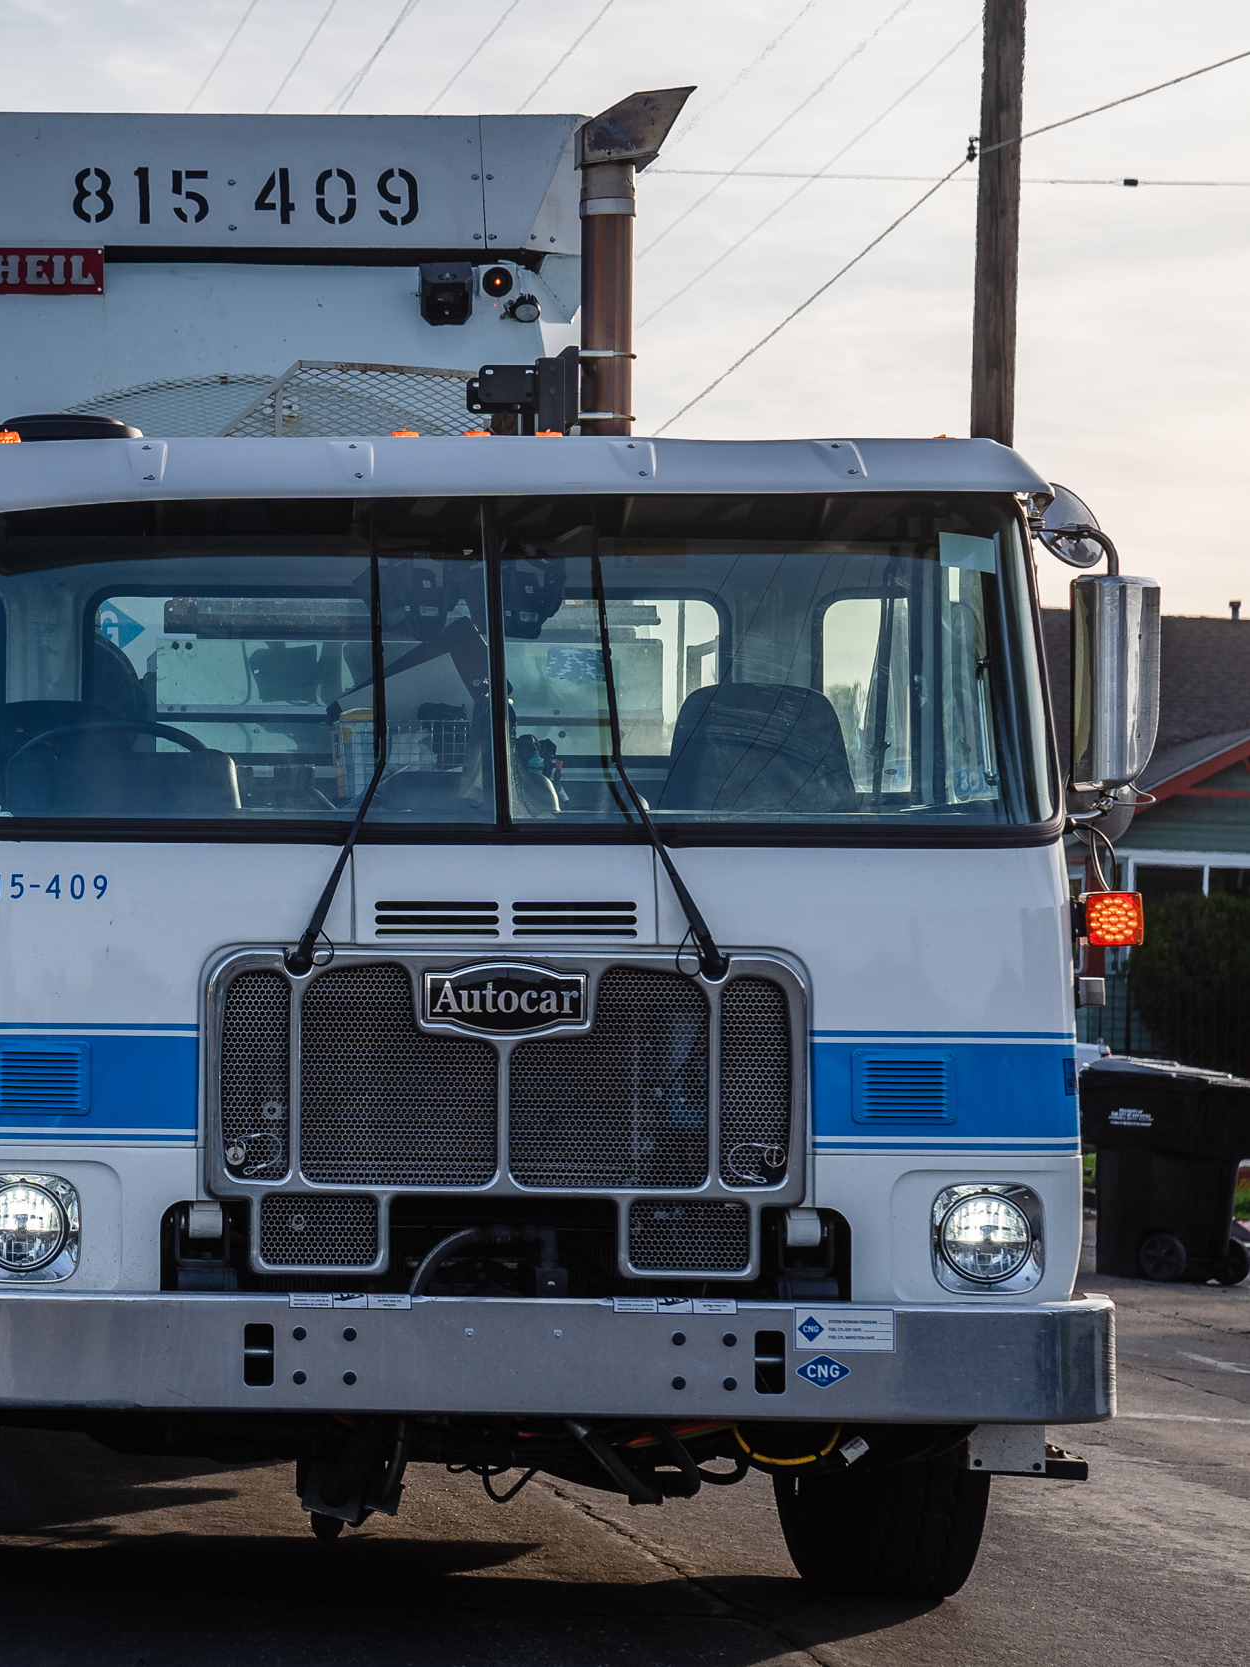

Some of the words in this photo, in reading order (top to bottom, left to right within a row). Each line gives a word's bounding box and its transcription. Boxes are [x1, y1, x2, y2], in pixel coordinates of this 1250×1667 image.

[72, 166, 209, 225] 815
[254, 167, 419, 226] 409
[432, 980, 579, 1014] Autocar
[802, 1325, 820, 1333] CNG
[806, 1364, 840, 1378] CNG
